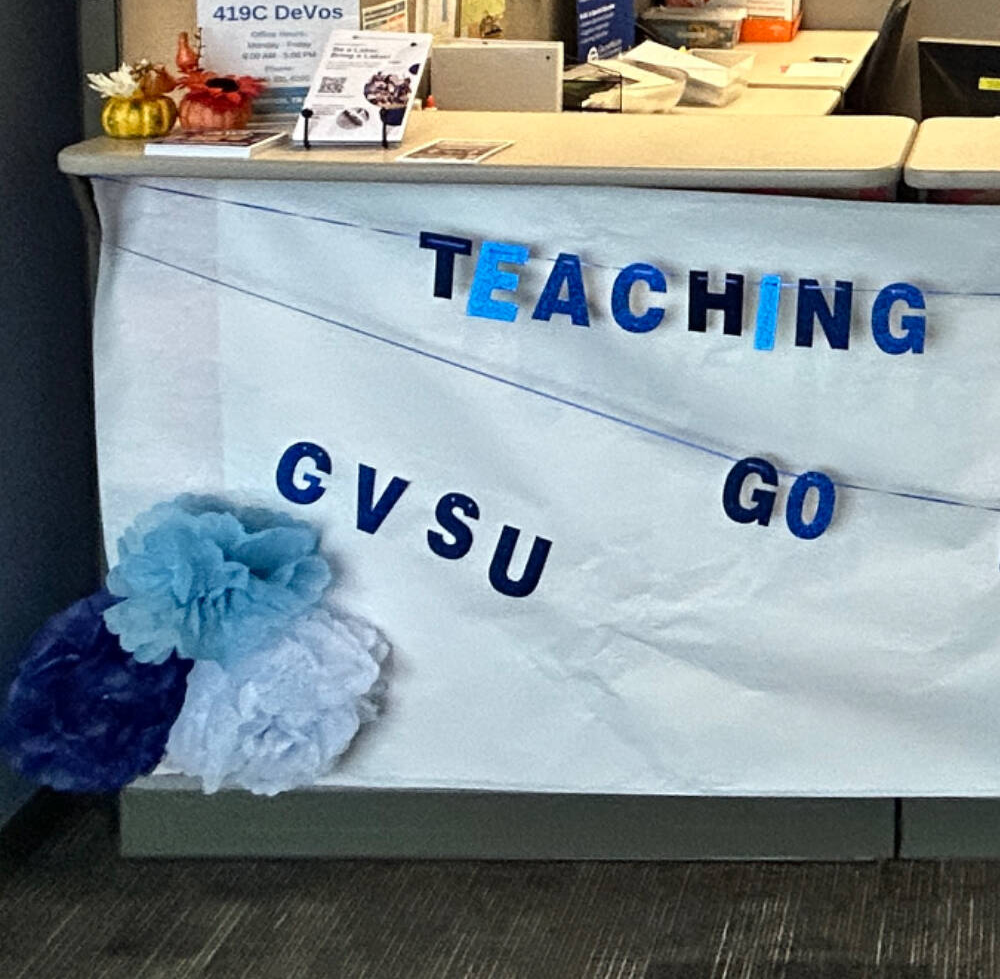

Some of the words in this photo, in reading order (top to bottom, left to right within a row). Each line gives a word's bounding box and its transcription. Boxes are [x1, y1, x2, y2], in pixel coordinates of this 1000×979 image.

[213, 5, 268, 21] 419C
[274, 4, 343, 20] DeVos
[419, 231, 927, 355] TEACHING
[722, 456, 836, 541] GO
